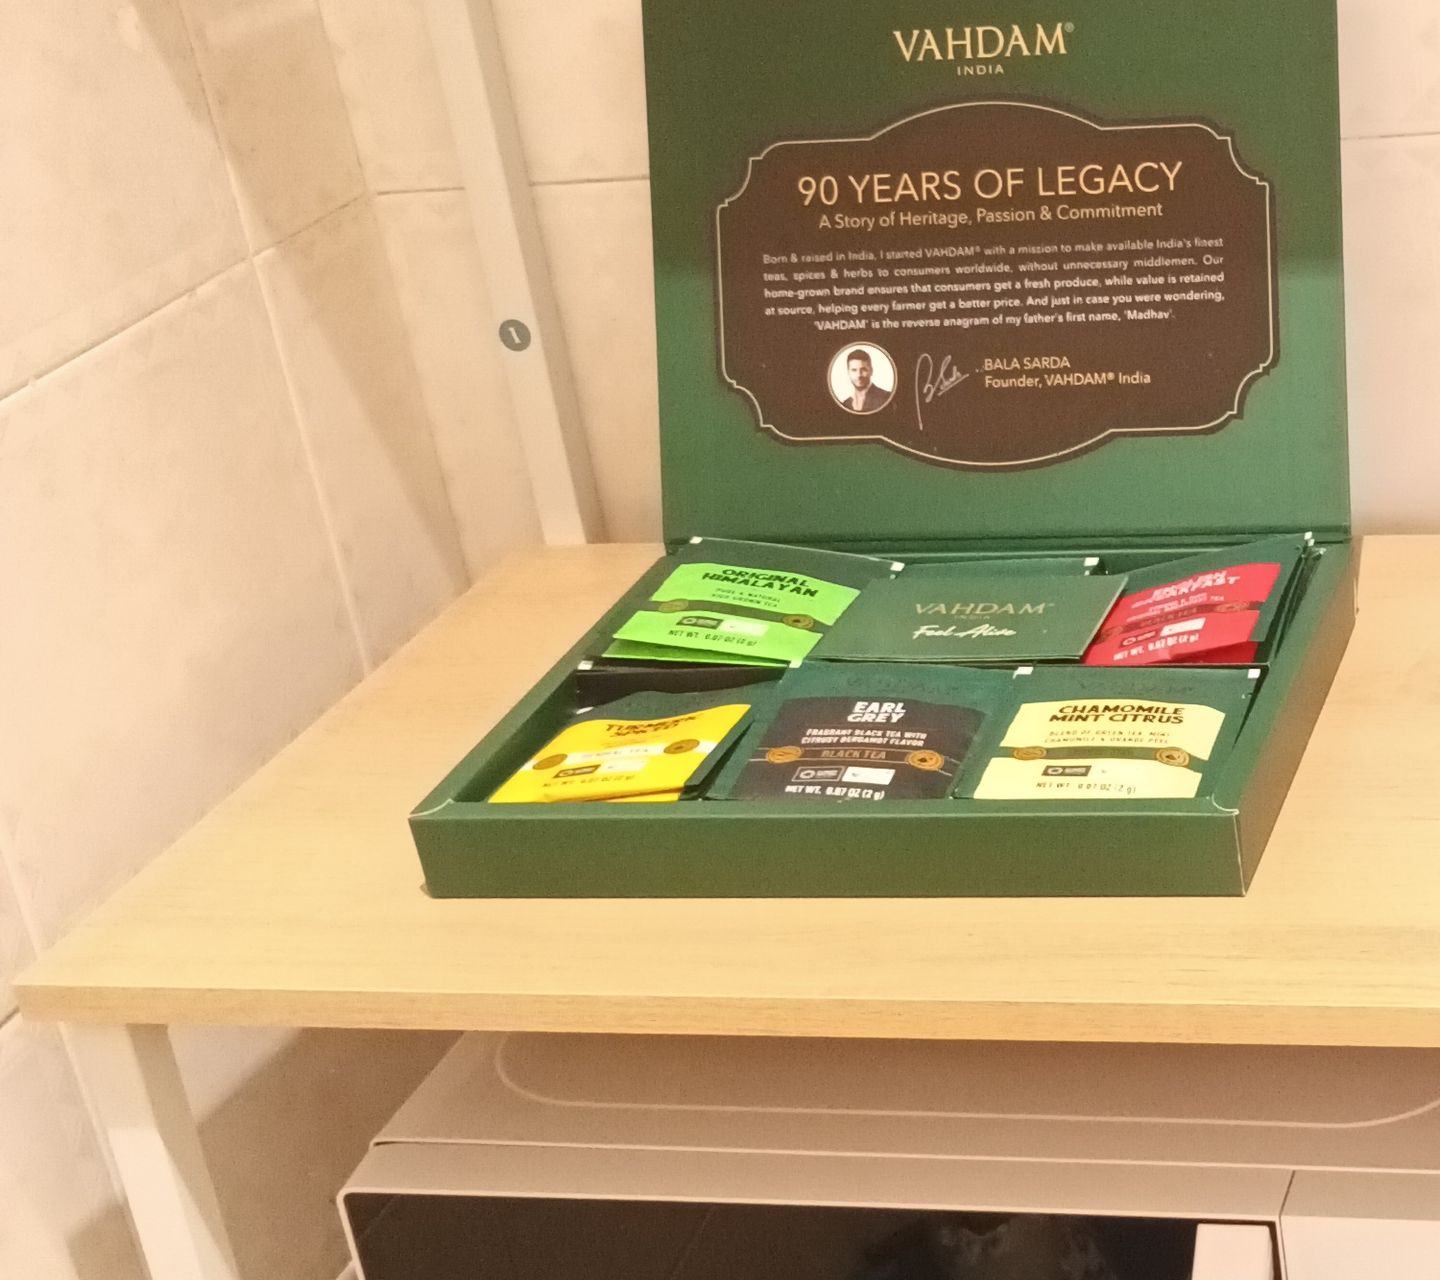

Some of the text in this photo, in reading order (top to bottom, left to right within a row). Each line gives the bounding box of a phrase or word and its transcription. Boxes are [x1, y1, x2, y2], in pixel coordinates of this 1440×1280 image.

[956, 63, 1005, 76] INDIA
[797, 160, 1183, 207] 90 YEARS OF LEGACY
[819, 202, 1163, 232] A Story of Heritage, Passion & Commitment
[762, 254, 788, 265] Born
[790, 253, 798, 263] &
[801, 251, 833, 263] raised
[836, 251, 846, 261] in
[886, 249, 923, 260] started
[984, 244, 1006, 255] with
[1009, 247, 1015, 255] a
[1018, 243, 1058, 254] mission
[1060, 243, 1072, 253] to
[1075, 242, 1103, 252] make
[1106, 239, 1154, 251] available
[1156, 238, 1192, 249] India's
[1195, 237, 1224, 247] finest
[793, 271, 826, 283] spices
[830, 268, 839, 279] &
[843, 267, 874, 278] herbs
[877, 267, 890, 277] to
[894, 267, 951, 278] consumers
[954, 262, 1014, 275] worldwide,
[1018, 261, 1059, 272] without
[1062, 260, 1129, 271] unnecessary
[1133, 256, 1198, 268] middlemen.
[1202, 254, 1224, 266] Our
[763, 271, 1225, 300] home-grown brand ensures that consumers get a fresh produce, while value is retained
[764, 307, 776, 316] at
[818, 303, 859, 316] helping
[860, 304, 890, 315] every
[892, 300, 926, 311] farmer
[928, 300, 947, 312] get
[949, 301, 956, 309] a
[958, 298, 991, 309] better
[993, 298, 1024, 310] price.
[1026, 295, 1049, 307] And
[1050, 295, 1071, 308] just
[1073, 294, 1083, 305] in
[1085, 295, 1110, 305] case
[1112, 294, 1133, 306] you
[1134, 293, 1161, 303] were
[1163, 290, 1225, 303] wondering,
[871, 319, 881, 330] is
[882, 318, 899, 329] the
[901, 318, 941, 329] reverse
[943, 317, 989, 329] anagram
[991, 314, 1003, 324] of
[1005, 315, 1021, 326] my
[1023, 312, 1064, 324] father's
[1065, 311, 1086, 322] first
[1088, 312, 1122, 323] name,
[984, 356, 1071, 372] BALA SARDA
[984, 374, 1043, 389] Founder,
[1118, 371, 1151, 385] India
[701, 572, 819, 598] HIMALAYAN
[721, 568, 811, 588] ORIGINAL
[912, 624, 957, 640] Feel
[851, 701, 907, 713] EARL
[1058, 704, 1186, 715] CHAMOMILE
[846, 712, 905, 723] GREY
[1048, 713, 1184, 724] MINT CITRUS
[886, 730, 902, 738] TEA
[821, 749, 887, 760] BLACK TEA
[784, 785, 805, 793] NET
[847, 787, 861, 798] OZ
